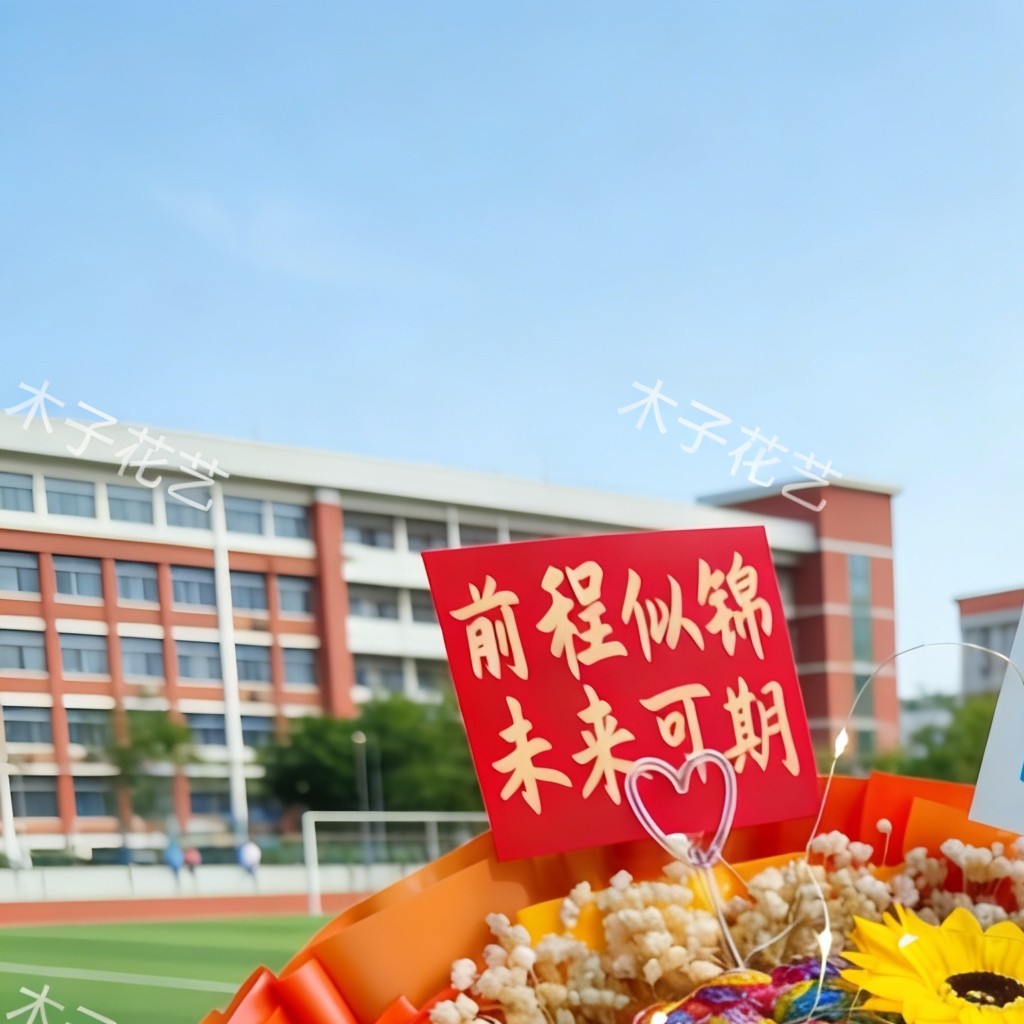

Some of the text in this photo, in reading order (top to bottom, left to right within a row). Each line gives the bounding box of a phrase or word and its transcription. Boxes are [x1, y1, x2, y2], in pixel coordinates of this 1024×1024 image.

[449, 551, 773, 681] 前程似锦
[491, 676, 800, 815] 未来可期
